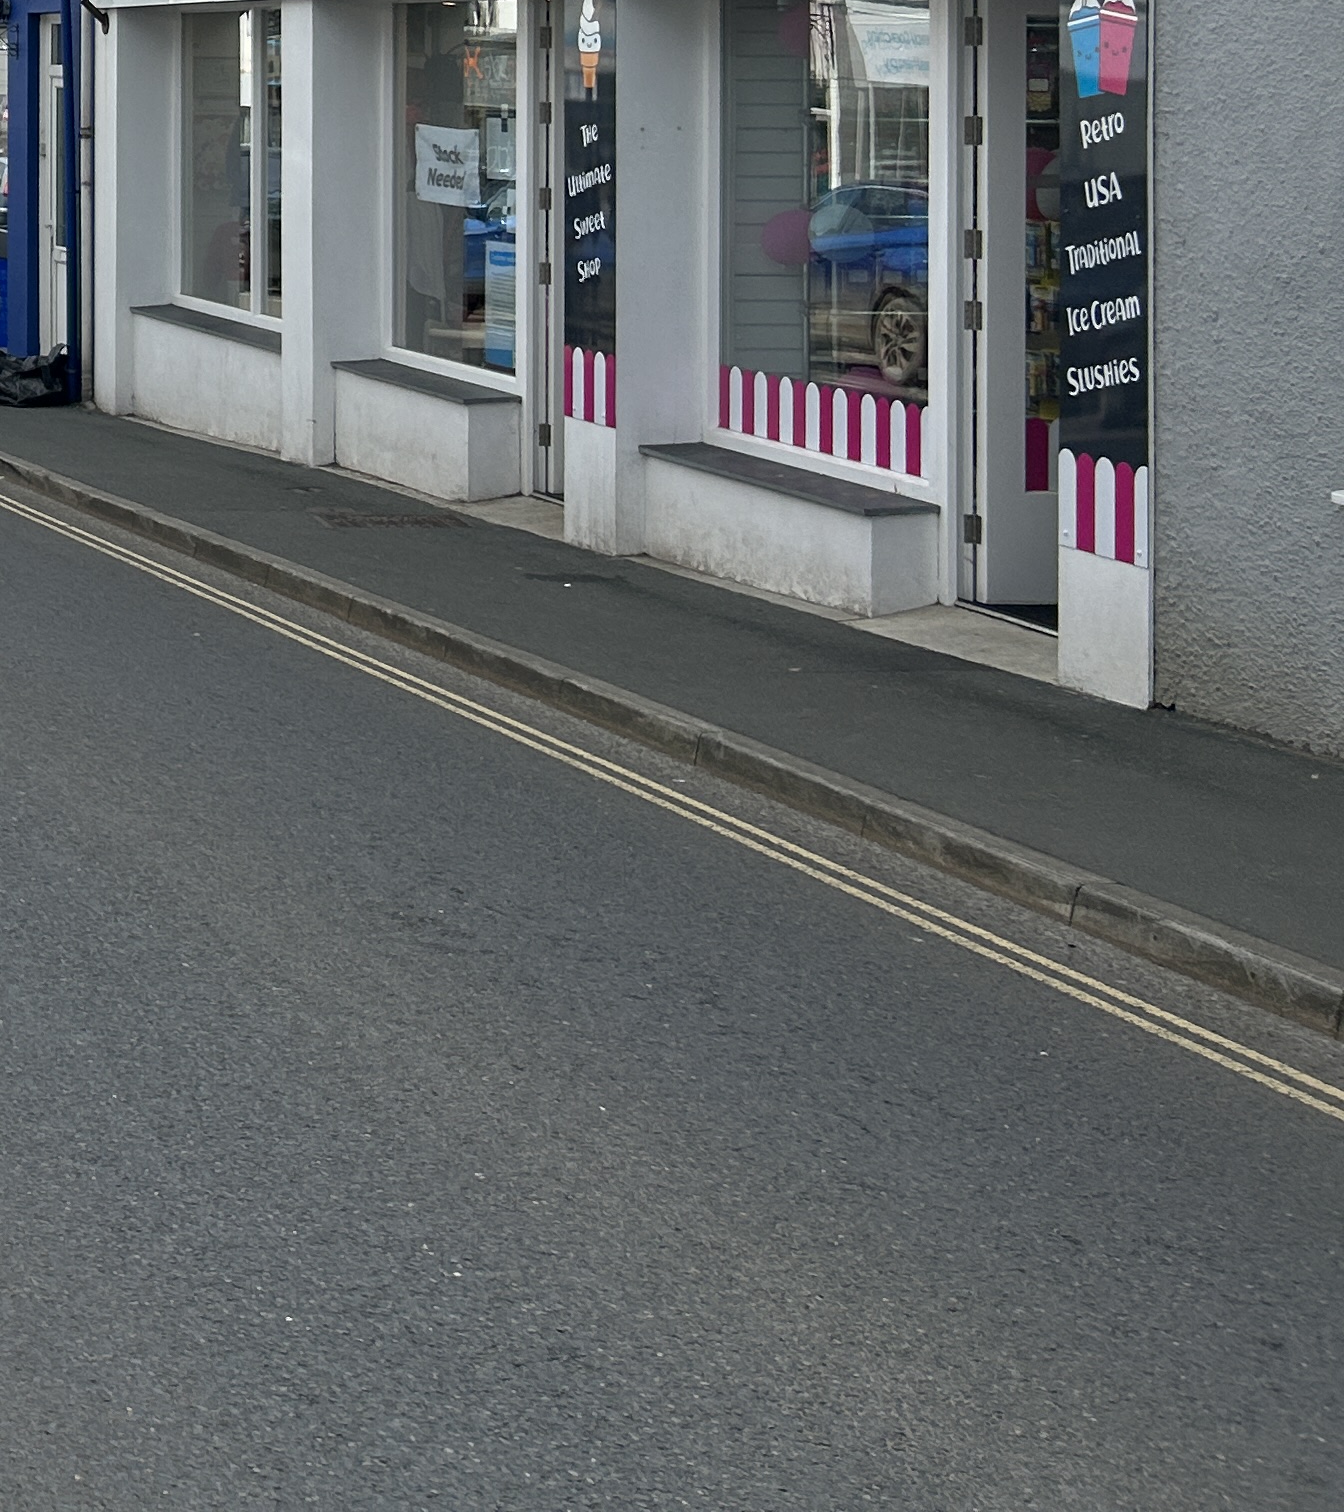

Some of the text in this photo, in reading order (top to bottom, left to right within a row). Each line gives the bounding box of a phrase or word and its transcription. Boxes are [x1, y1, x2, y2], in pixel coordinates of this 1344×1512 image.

[1080, 111, 1125, 150] Retro
[432, 142, 465, 165] Stock
[1084, 171, 1123, 209] USA
[573, 211, 606, 240] Sweet
[1066, 311, 1090, 336] Ice
